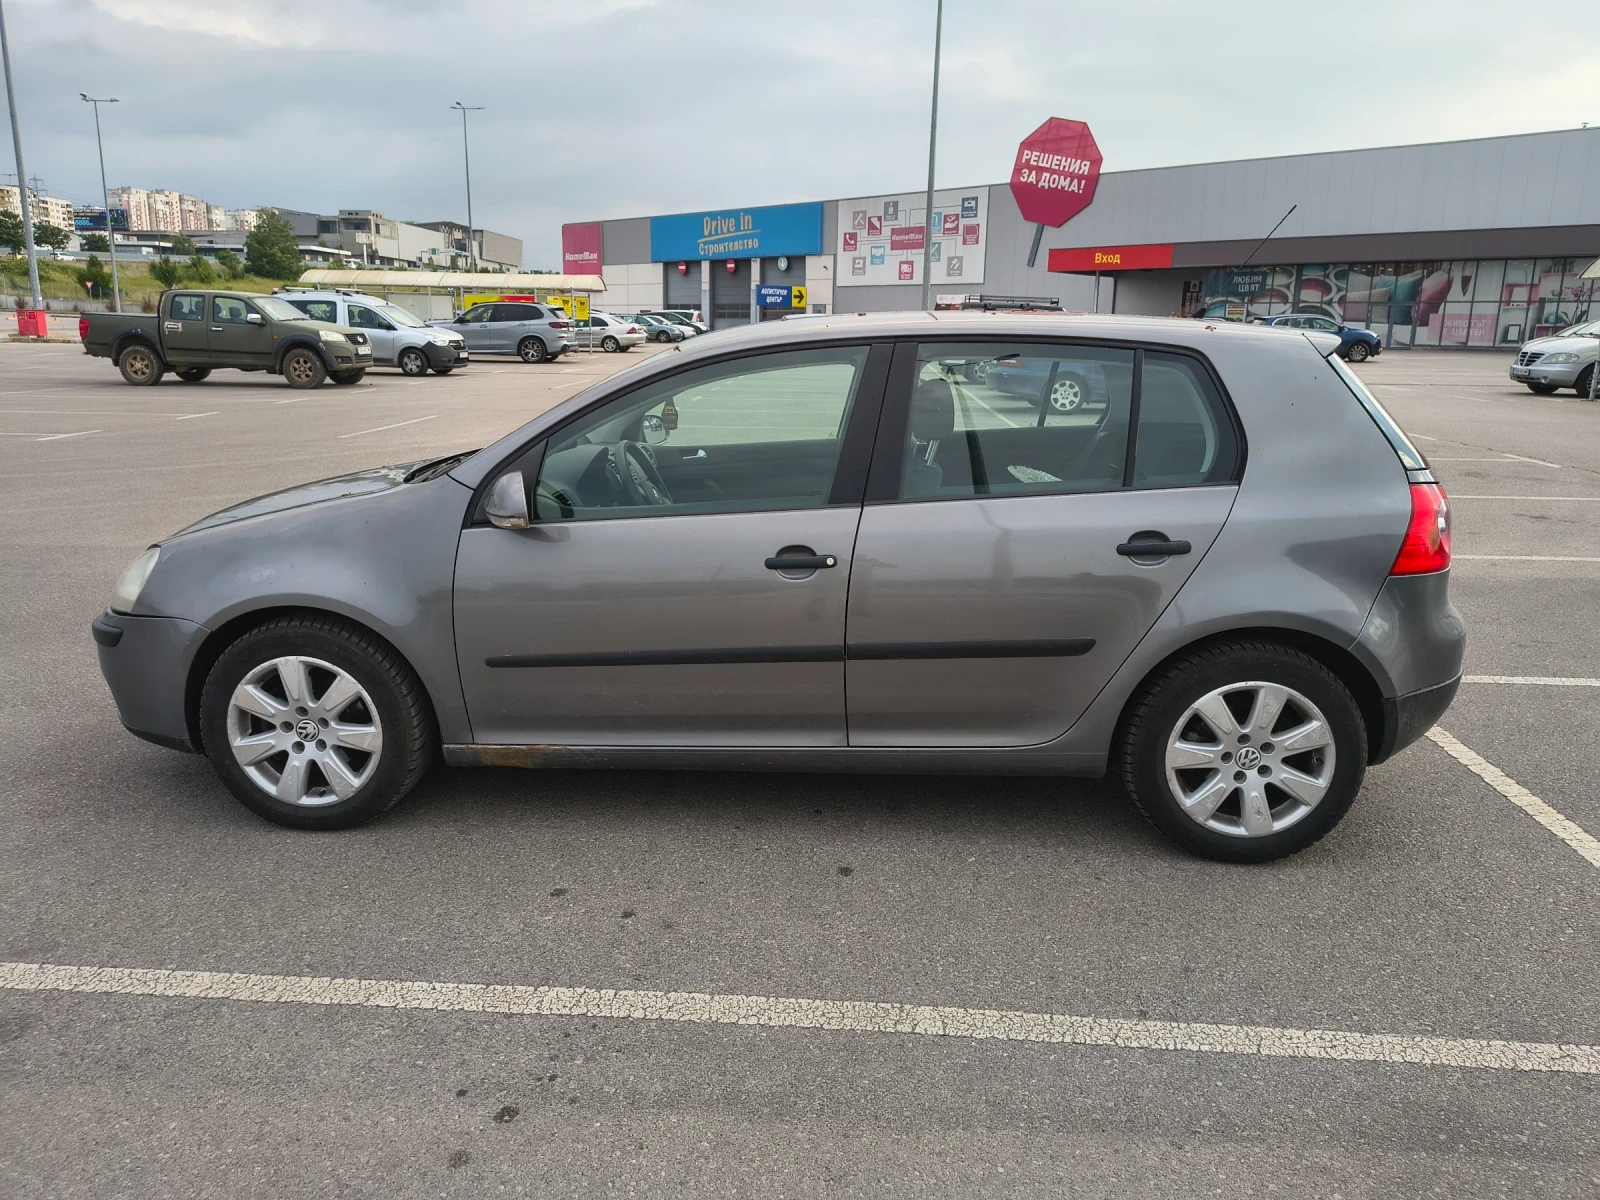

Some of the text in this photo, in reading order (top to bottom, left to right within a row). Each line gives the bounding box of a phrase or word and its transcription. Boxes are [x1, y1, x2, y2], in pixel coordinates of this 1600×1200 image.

[1021, 149, 1091, 175] РЕШЕНИЯ
[1020, 168, 1086, 194] ЗА ДОМА!
[703, 212, 752, 236] Drive in
[891, 233, 923, 241] HomeMax
[699, 238, 759, 257] Строителство
[565, 251, 598, 261] HomeMax
[1094, 252, 1121, 265] Вход
[1232, 275, 1262, 284] ЛЮБИМ
[1238, 284, 1260, 293] ЦВЯТ
[1444, 320, 1487, 328] ЖИВОТЪТ
[1452, 328, 1485, 336] ЦВЕТЕН
